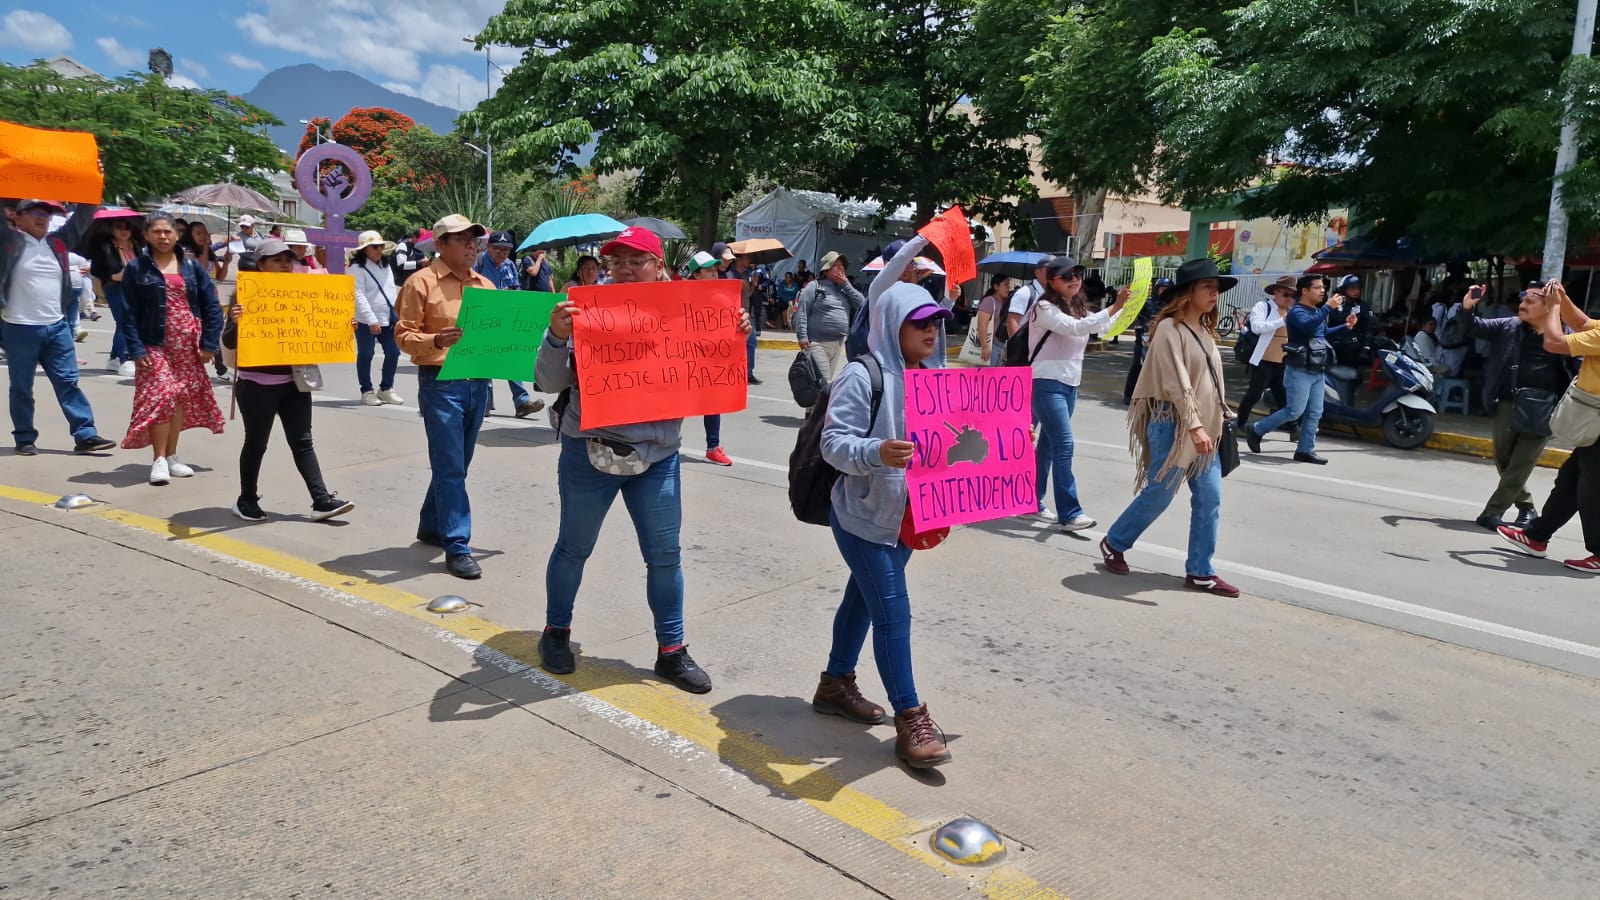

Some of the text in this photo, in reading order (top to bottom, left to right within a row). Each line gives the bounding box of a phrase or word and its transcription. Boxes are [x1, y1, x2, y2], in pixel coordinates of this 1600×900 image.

[750, 225, 773, 234] OAXACA
[246, 300, 270, 314] QUE
[274, 302, 288, 312] CON
[291, 302, 306, 313] SUS
[290, 316, 298, 326] AL
[303, 313, 339, 330] PUEBLO
[343, 320, 351, 330] Y
[583, 295, 739, 334] NO PUEDE HABER
[260, 329, 274, 340] SUS
[276, 327, 308, 340] HECHOS
[315, 330, 327, 339] LO
[664, 336, 732, 361] CUANDO
[585, 360, 748, 396] EXISTE LA RAZÓN
[912, 367, 1025, 416] ESTE DIÁLOGO
[906, 426, 1026, 471] NO LO
[918, 470, 1035, 522] ENTENDEMOS
